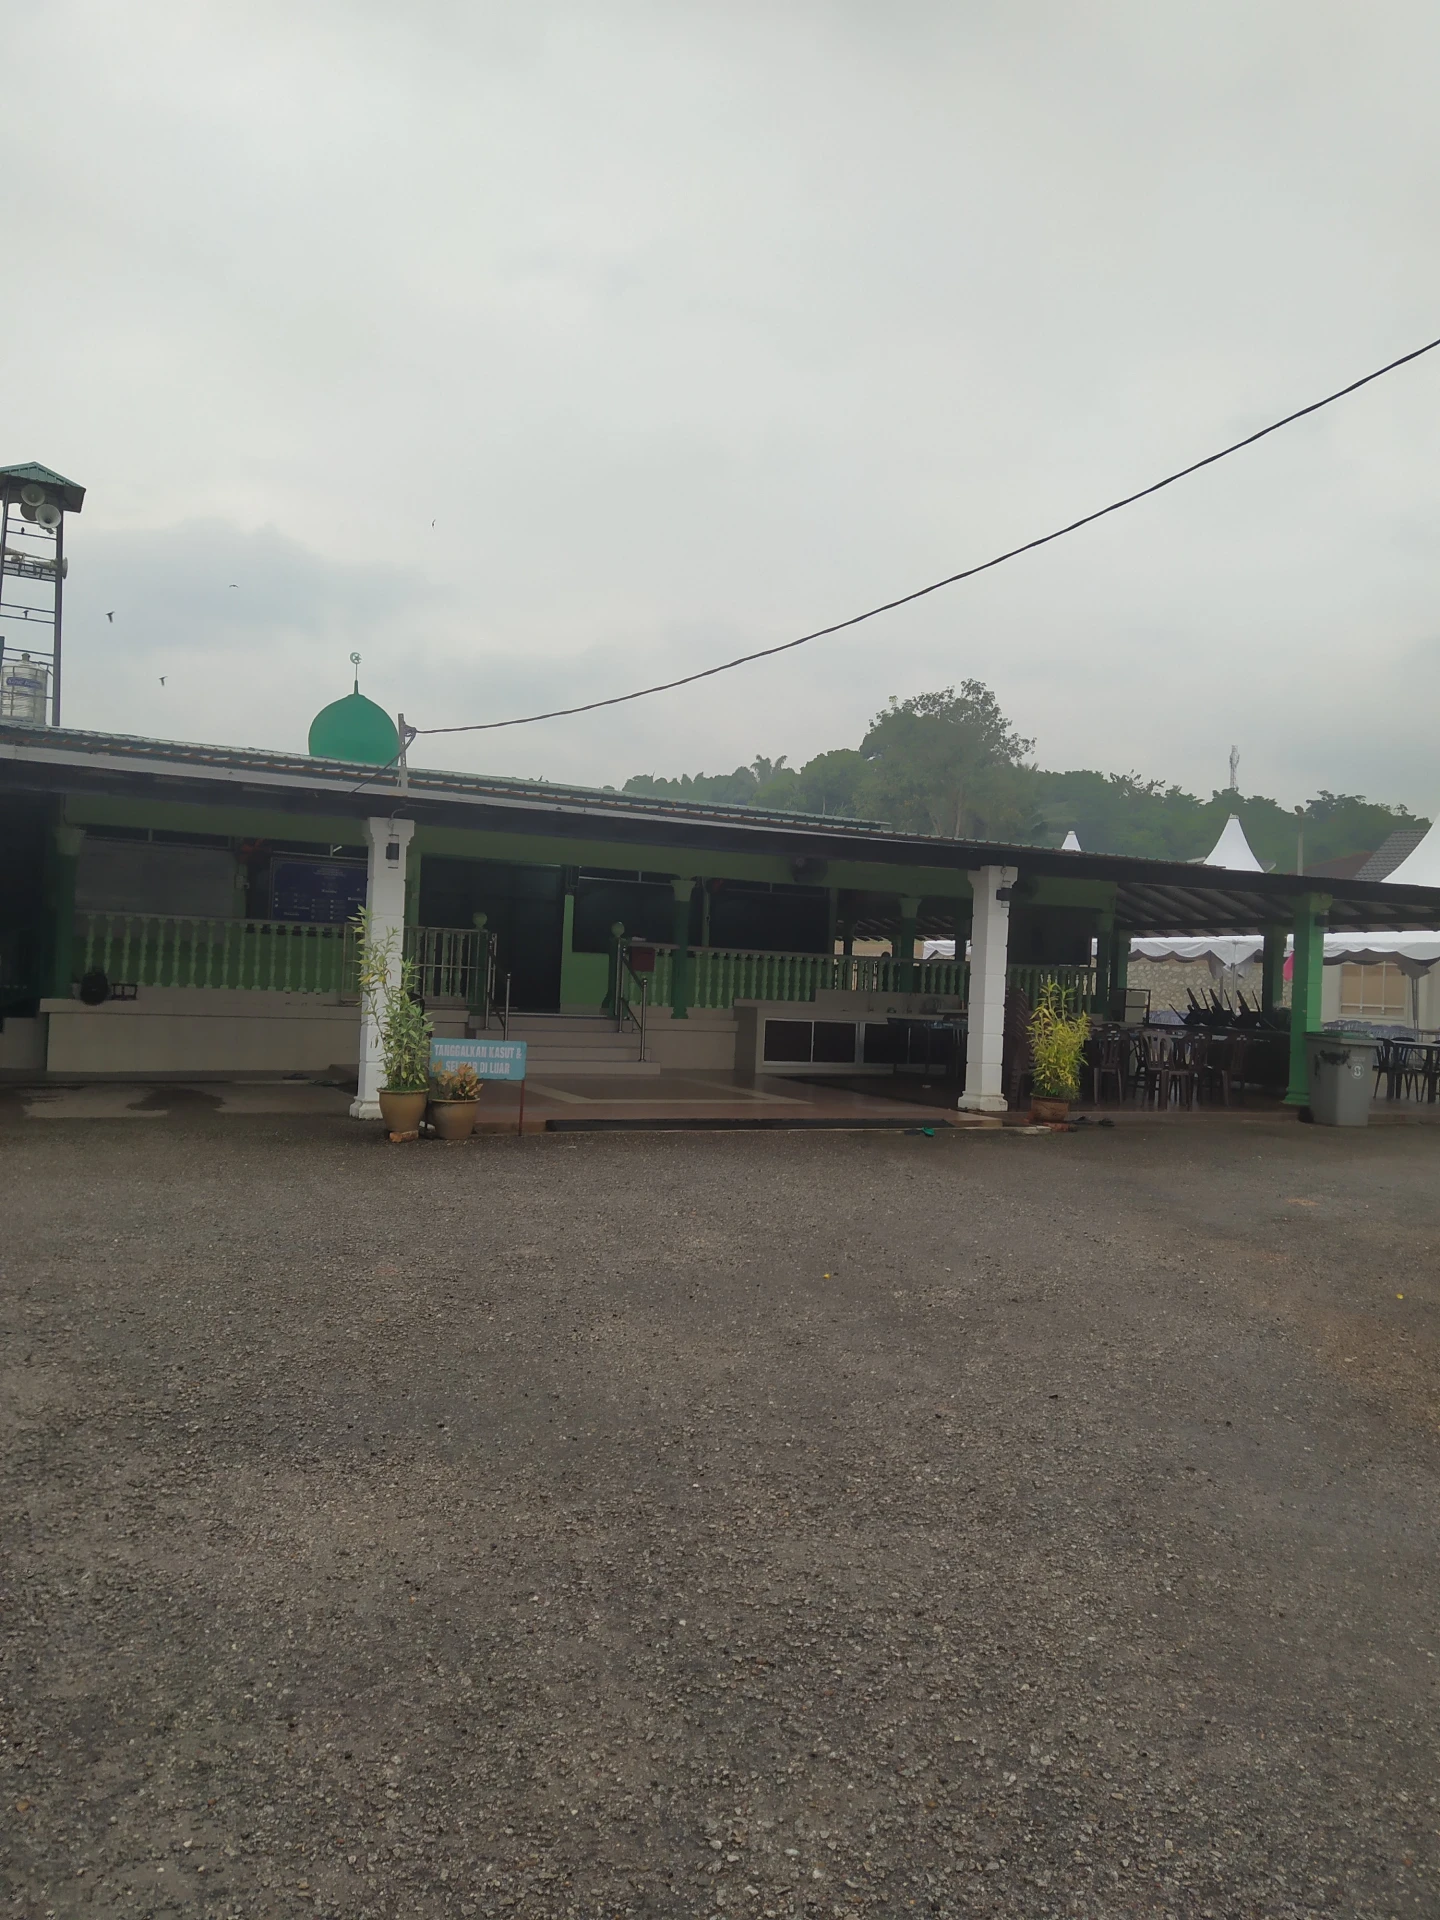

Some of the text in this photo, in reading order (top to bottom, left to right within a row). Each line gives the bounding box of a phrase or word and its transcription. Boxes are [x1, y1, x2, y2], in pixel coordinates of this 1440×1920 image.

[434, 1044, 522, 1059] TANGGALKAN KASUT &
[480, 1061, 488, 1073] DI
[490, 1062, 511, 1074] LUAR
